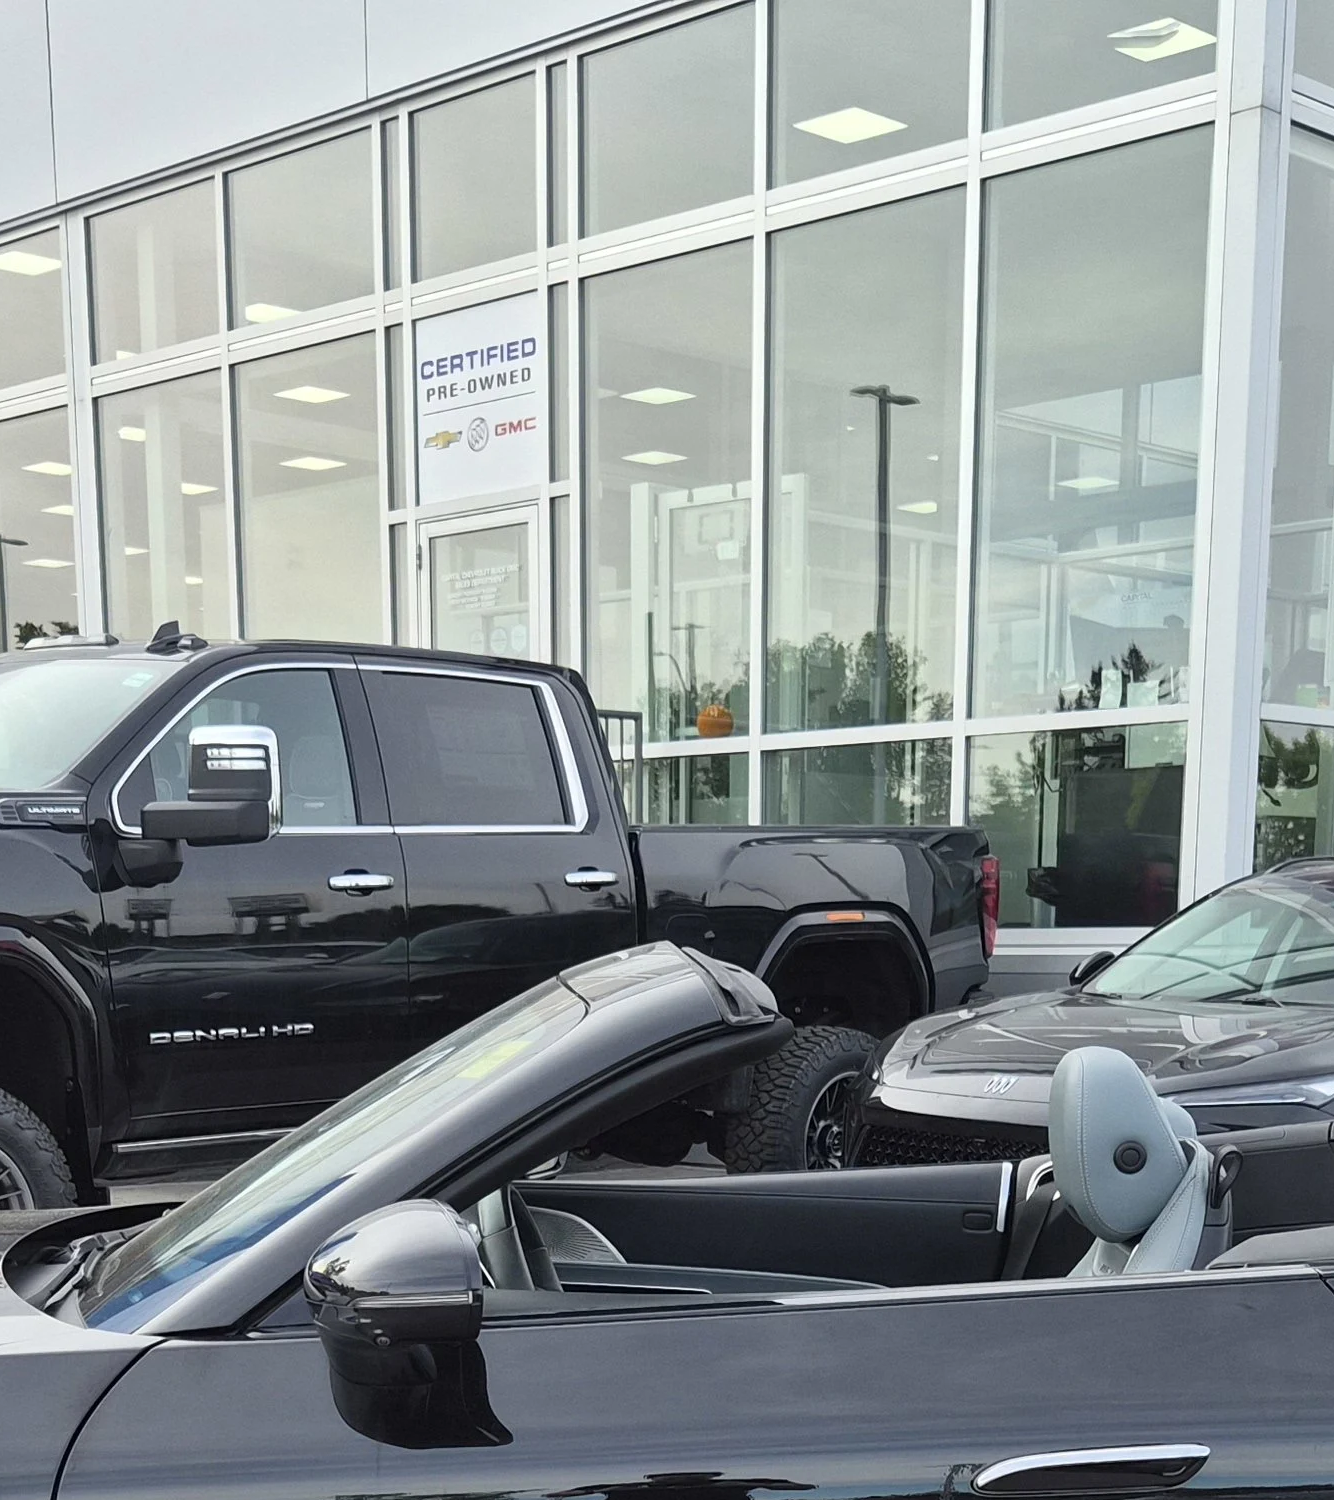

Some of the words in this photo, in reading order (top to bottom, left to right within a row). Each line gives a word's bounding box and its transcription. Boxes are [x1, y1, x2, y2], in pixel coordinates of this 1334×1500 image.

[420, 337, 537, 380] CERTIFIED
[426, 367, 532, 402] PRE-OWNED
[494, 417, 537, 436] GMC
[149, 1025, 266, 1045] DENALI
[272, 1023, 315, 1037] HD
